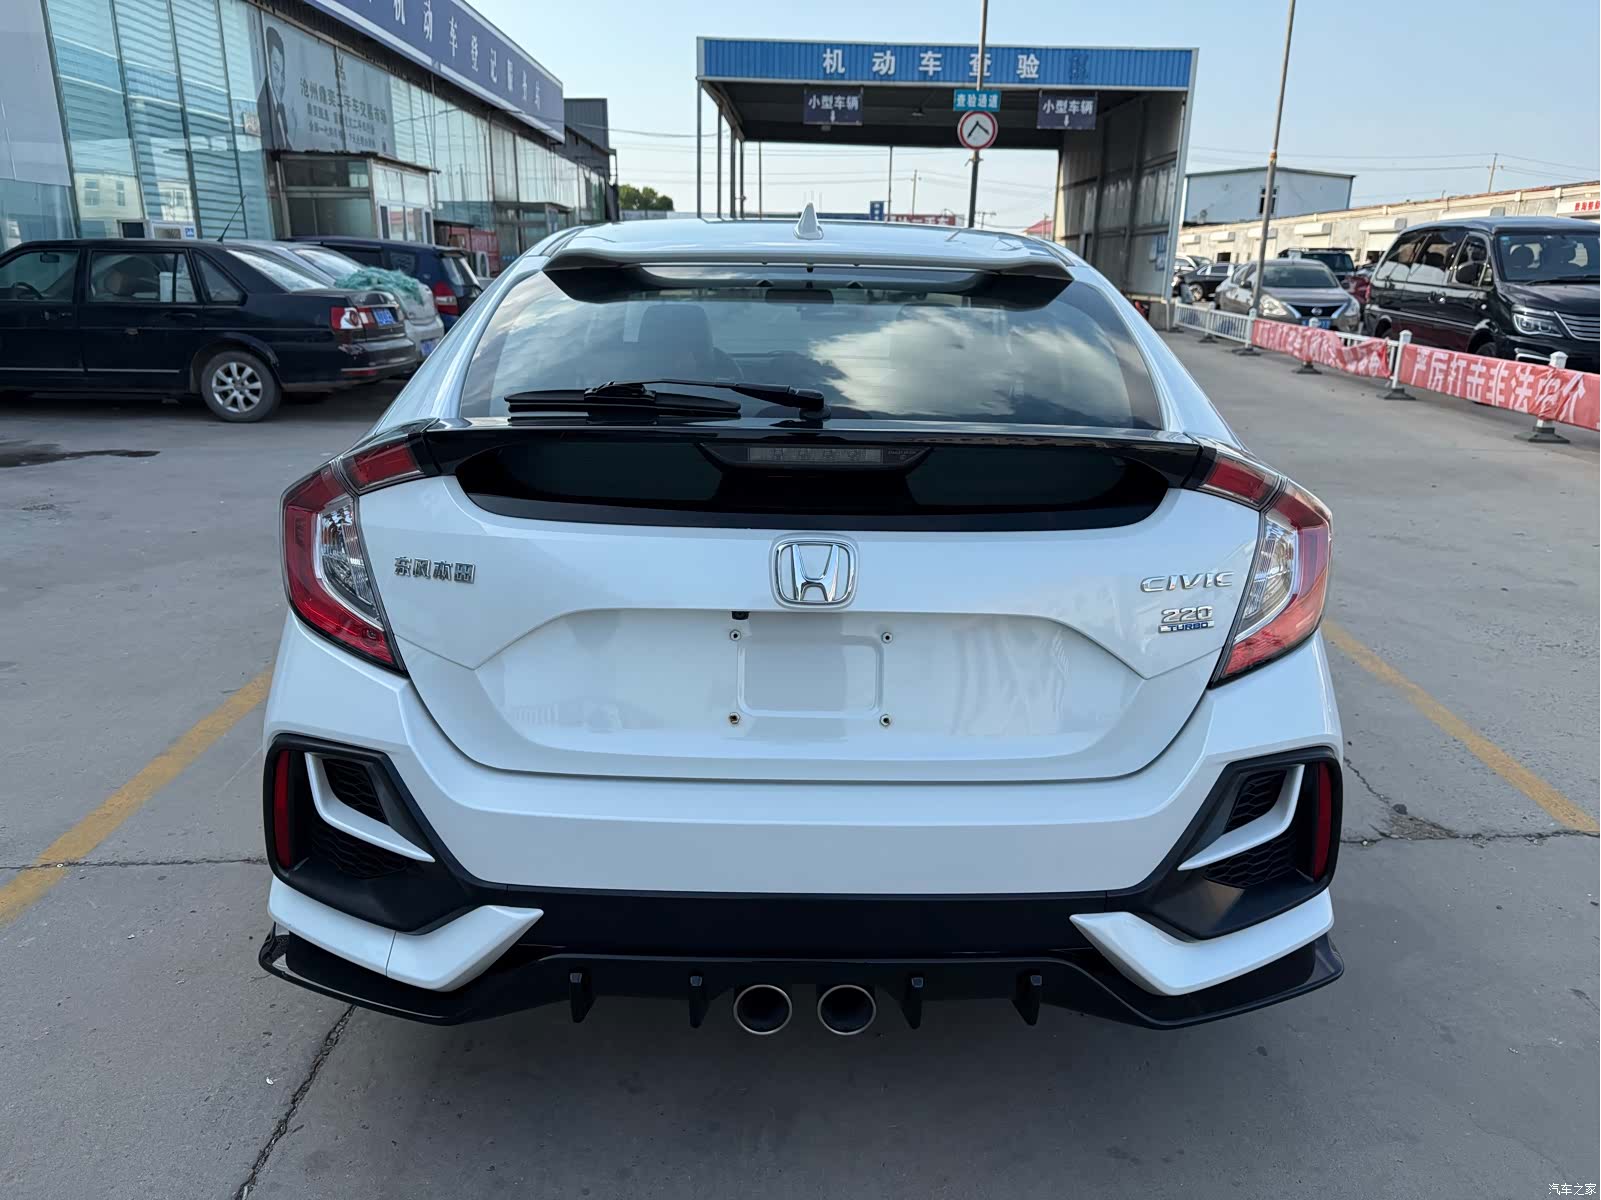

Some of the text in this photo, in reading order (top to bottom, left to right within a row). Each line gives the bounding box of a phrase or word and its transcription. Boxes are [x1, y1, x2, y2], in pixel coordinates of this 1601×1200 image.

[823, 48, 1040, 79] 机动车查验
[808, 95, 859, 111] 小型车辆
[956, 93, 998, 109] 查验通道
[1042, 99, 1094, 115] 小型车辆
[394, 556, 476, 584] 东风本田
[1141, 571, 1235, 592] CIVIC
[1161, 605, 1214, 623] 220
[1169, 621, 1209, 632] TURBO
